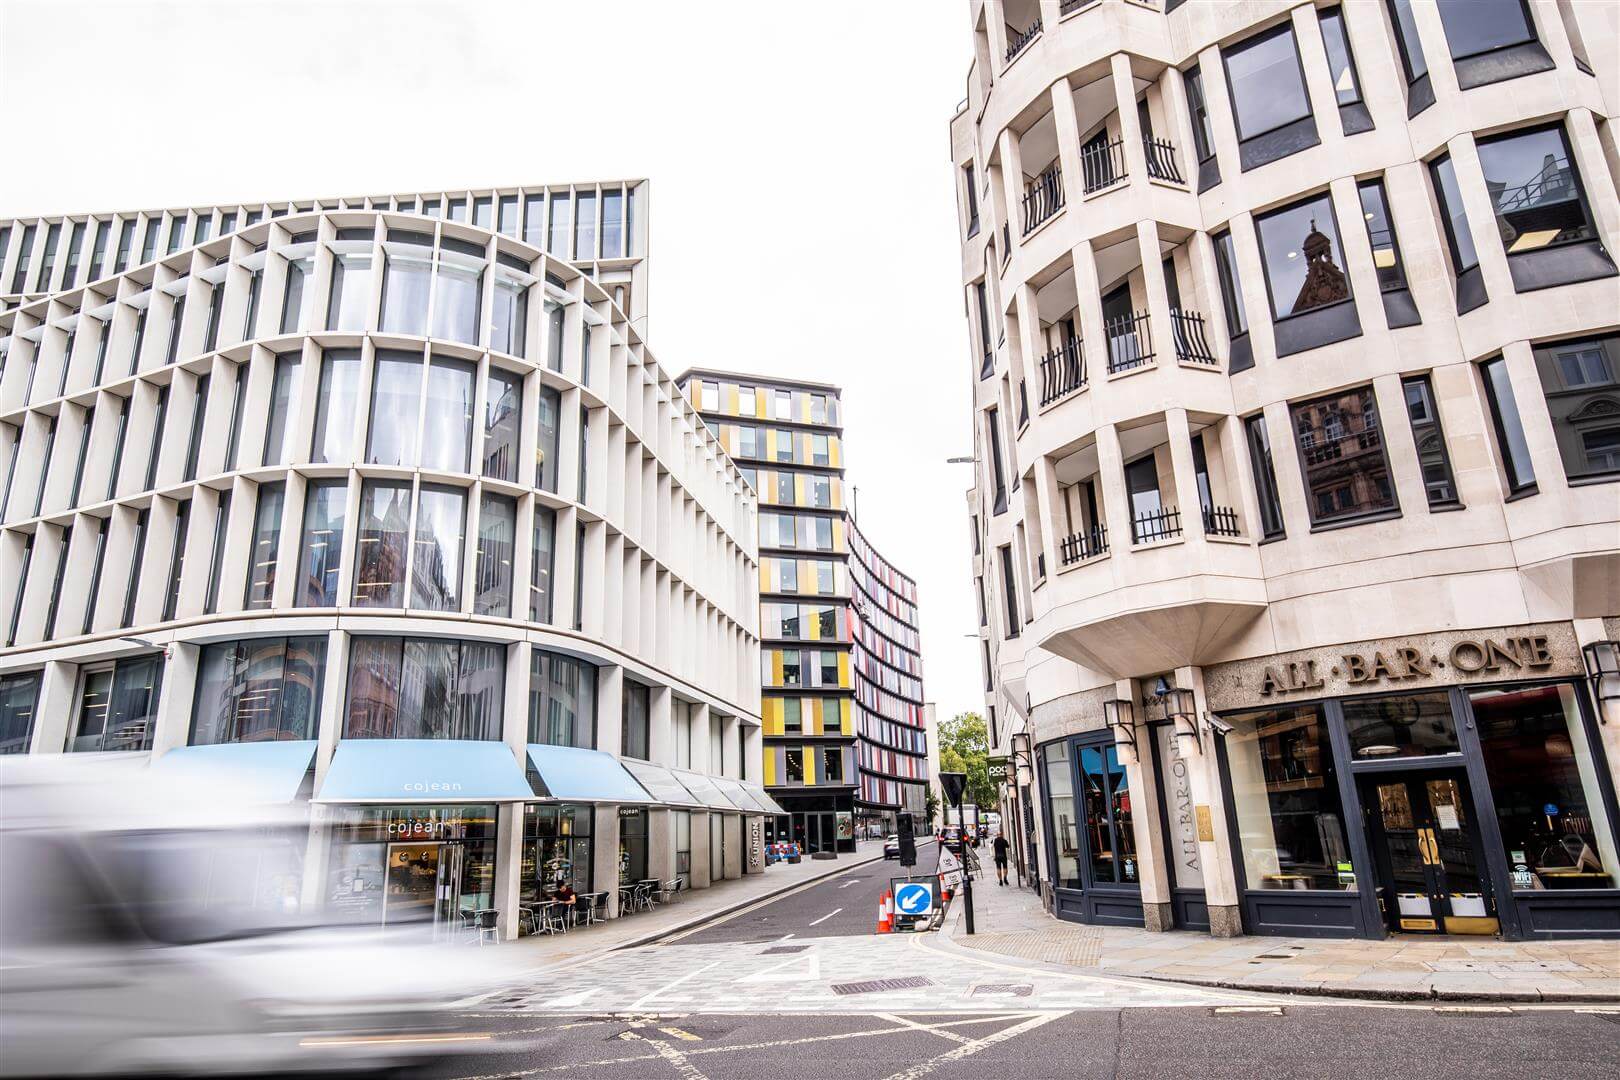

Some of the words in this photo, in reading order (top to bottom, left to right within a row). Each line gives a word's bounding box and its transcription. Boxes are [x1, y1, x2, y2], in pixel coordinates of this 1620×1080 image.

[1259, 660, 1324, 695] ALL
[1342, 647, 1431, 683] BAR
[1449, 634, 1553, 672] ONE
[403, 782, 462, 793] cojean
[1177, 785, 1193, 825] BAR
[388, 819, 444, 837] cojean
[752, 822, 760, 855] UNION
